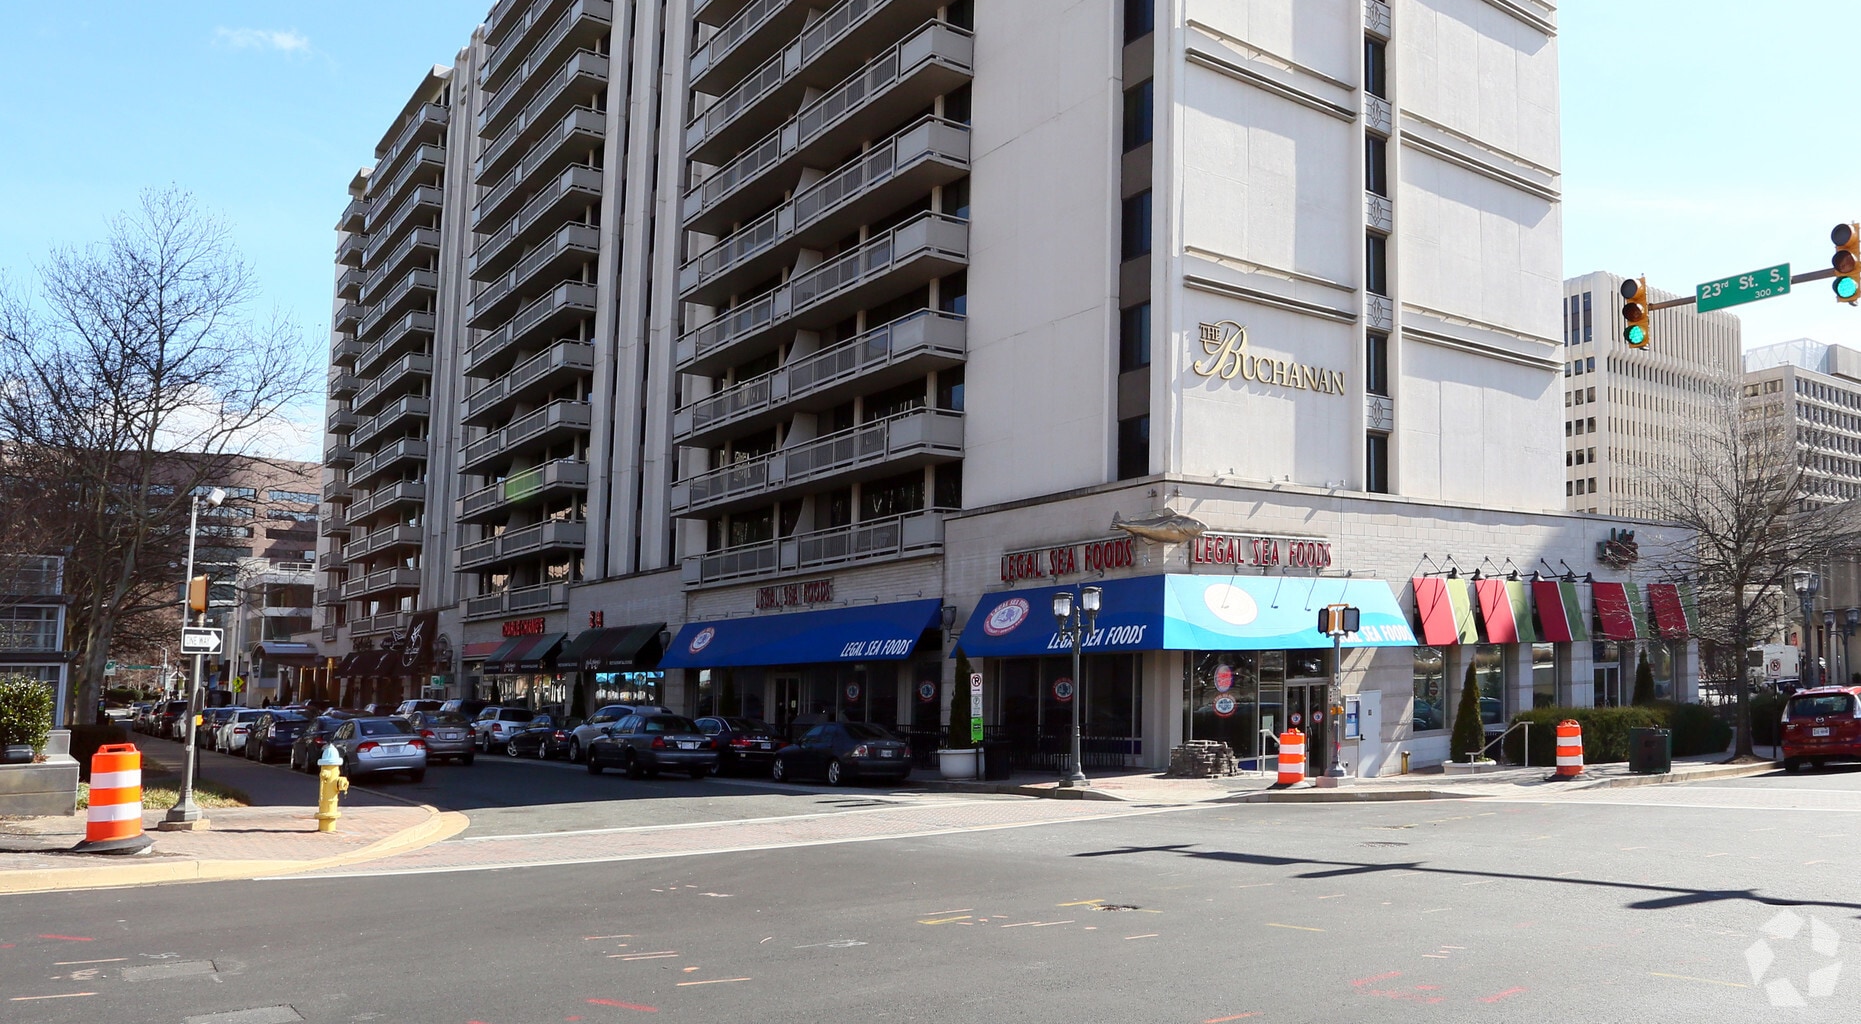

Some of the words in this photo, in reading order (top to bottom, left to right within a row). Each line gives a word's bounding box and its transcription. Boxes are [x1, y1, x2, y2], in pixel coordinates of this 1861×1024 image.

[1701, 280, 1729, 300] 23rd
[1739, 275, 1759, 290] St.
[1770, 268, 1784, 283] S.
[1754, 288, 1772, 299] 300
[1199, 325, 1221, 341] THE
[1193, 319, 1346, 395] BUCHANAN
[1001, 552, 1042, 581] LEGAL
[1049, 547, 1076, 575] SEA
[1084, 539, 1133, 571] FOODS
[1194, 536, 1245, 565] LEGAL
[1252, 539, 1280, 566] SEA
[1289, 540, 1332, 568] FOODS
[186, 635, 198, 646] ONE
[199, 636, 211, 646] WAY
[1046, 631, 1079, 650] LEGA
[1105, 624, 1147, 645] FOODS
[1360, 624, 1383, 643] SEA
[1380, 623, 1413, 642] FOODS
[839, 640, 867, 657] LEGAL
[864, 639, 884, 656] SEA
[880, 638, 913, 656] FOODS
